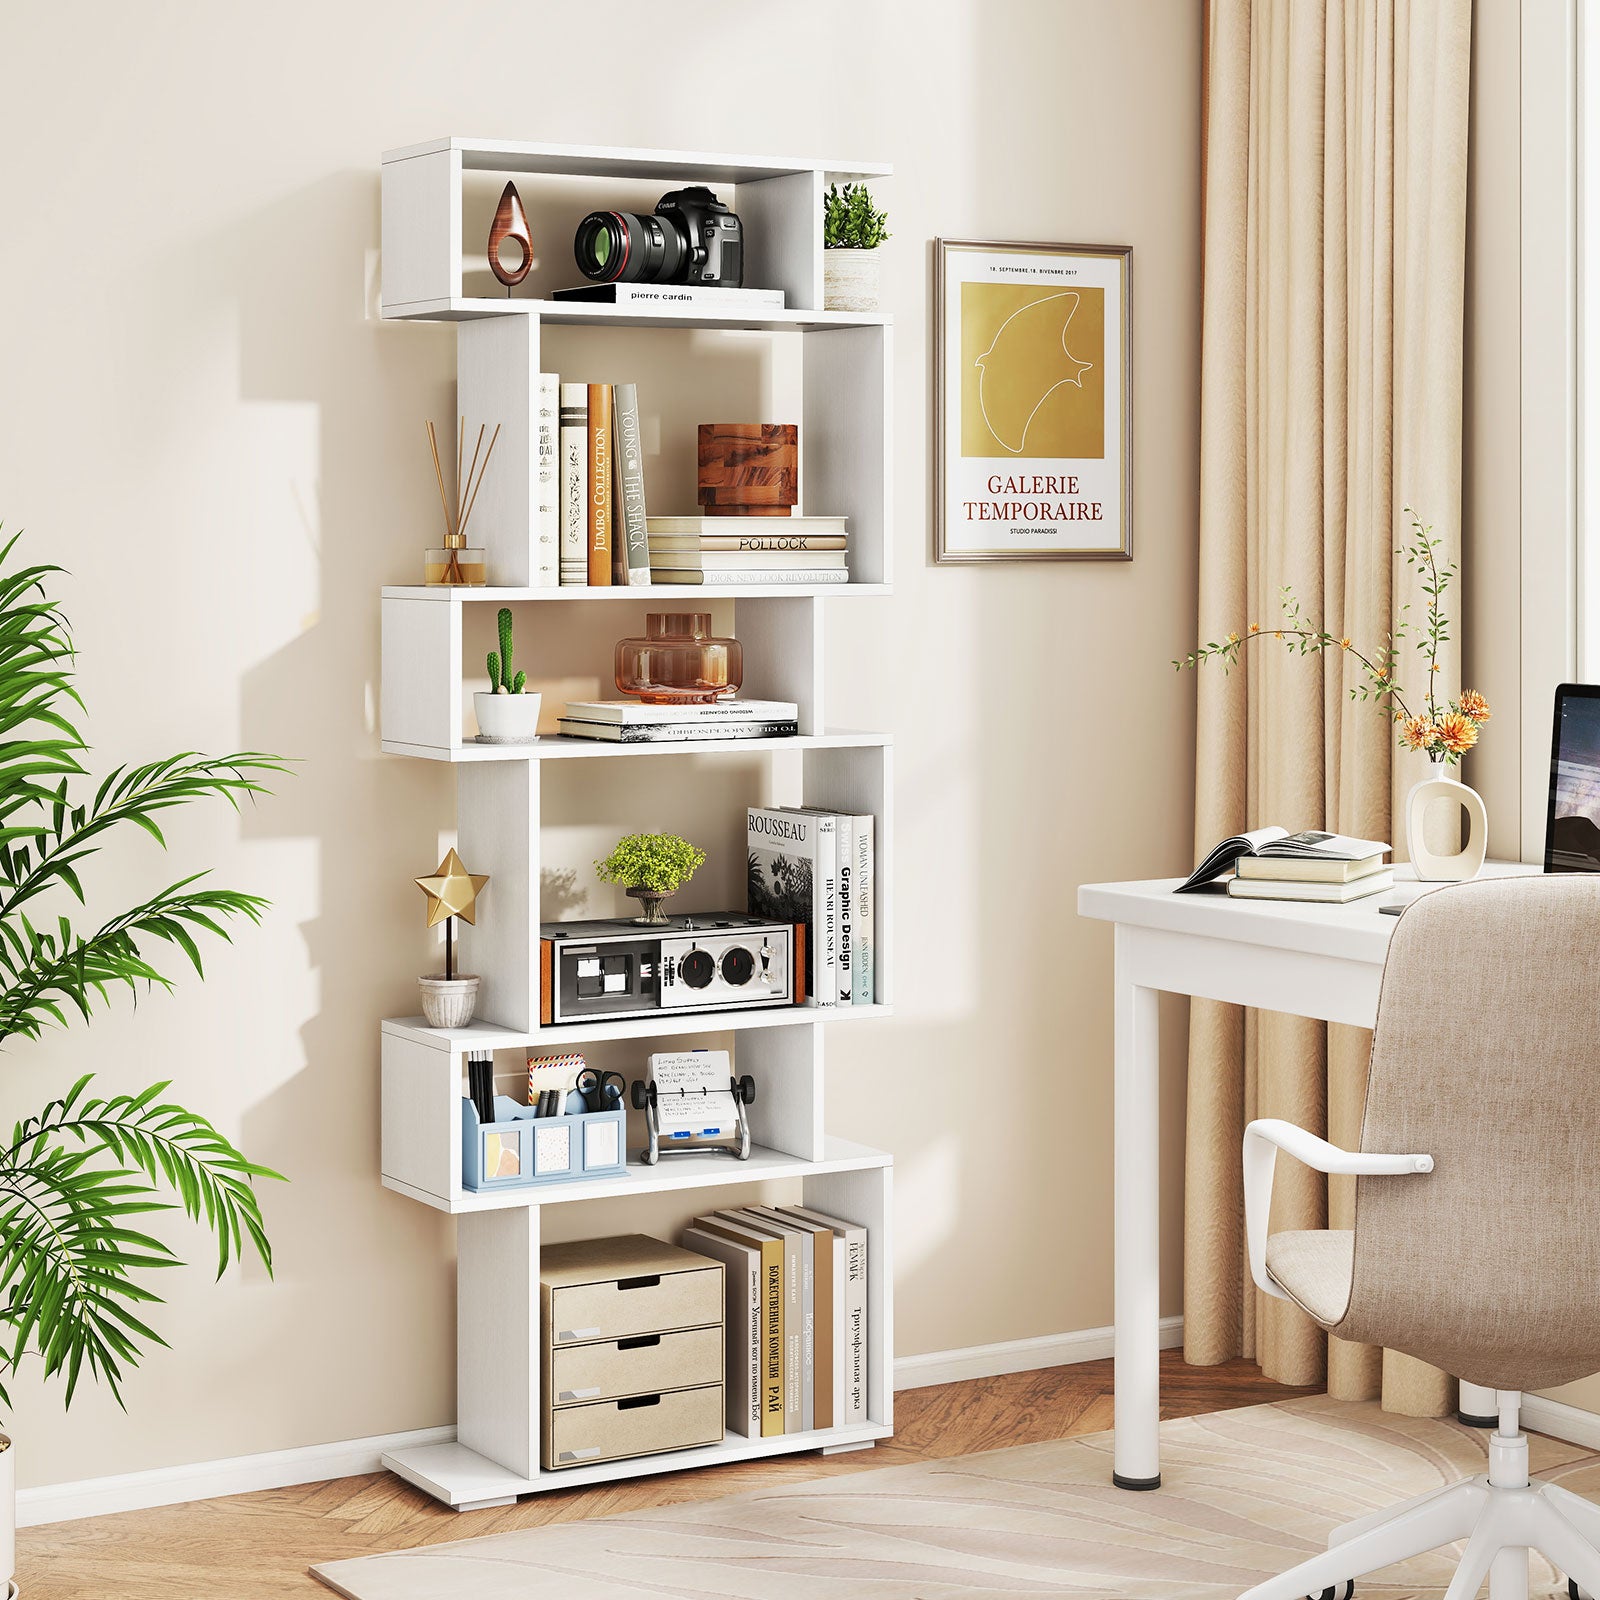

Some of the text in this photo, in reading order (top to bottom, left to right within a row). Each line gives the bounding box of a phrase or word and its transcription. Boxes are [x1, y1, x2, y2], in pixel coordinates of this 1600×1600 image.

[663, 293, 692, 301] cardin
[622, 408, 638, 458] YOUNG
[594, 427, 608, 551] JUMBO COLLECTION
[988, 475, 1079, 494] GALERIE
[624, 472, 645, 551] THE SHACK
[963, 502, 1103, 521] TEMPORAIRE
[739, 537, 808, 550] POLLOCK
[786, 573, 842, 582] REVOLUTION
[749, 815, 806, 841] ROUSSEAU
[859, 834, 868, 917] WOMAN UNLEASHED
[839, 822, 851, 970] Swiss Graphic Design
[850, 1242, 858, 1282] РЕМАРК
[752, 1306, 760, 1345] Уличный
[768, 1265, 779, 1378] БОЖЕСТВЕННАЯ КОМЕДИЯ
[803, 1313, 814, 1365] Избранное
[752, 1364, 758, 1374] по
[850, 1307, 861, 1410] Триумфальная арка
[769, 1386, 782, 1413] РАЙ
